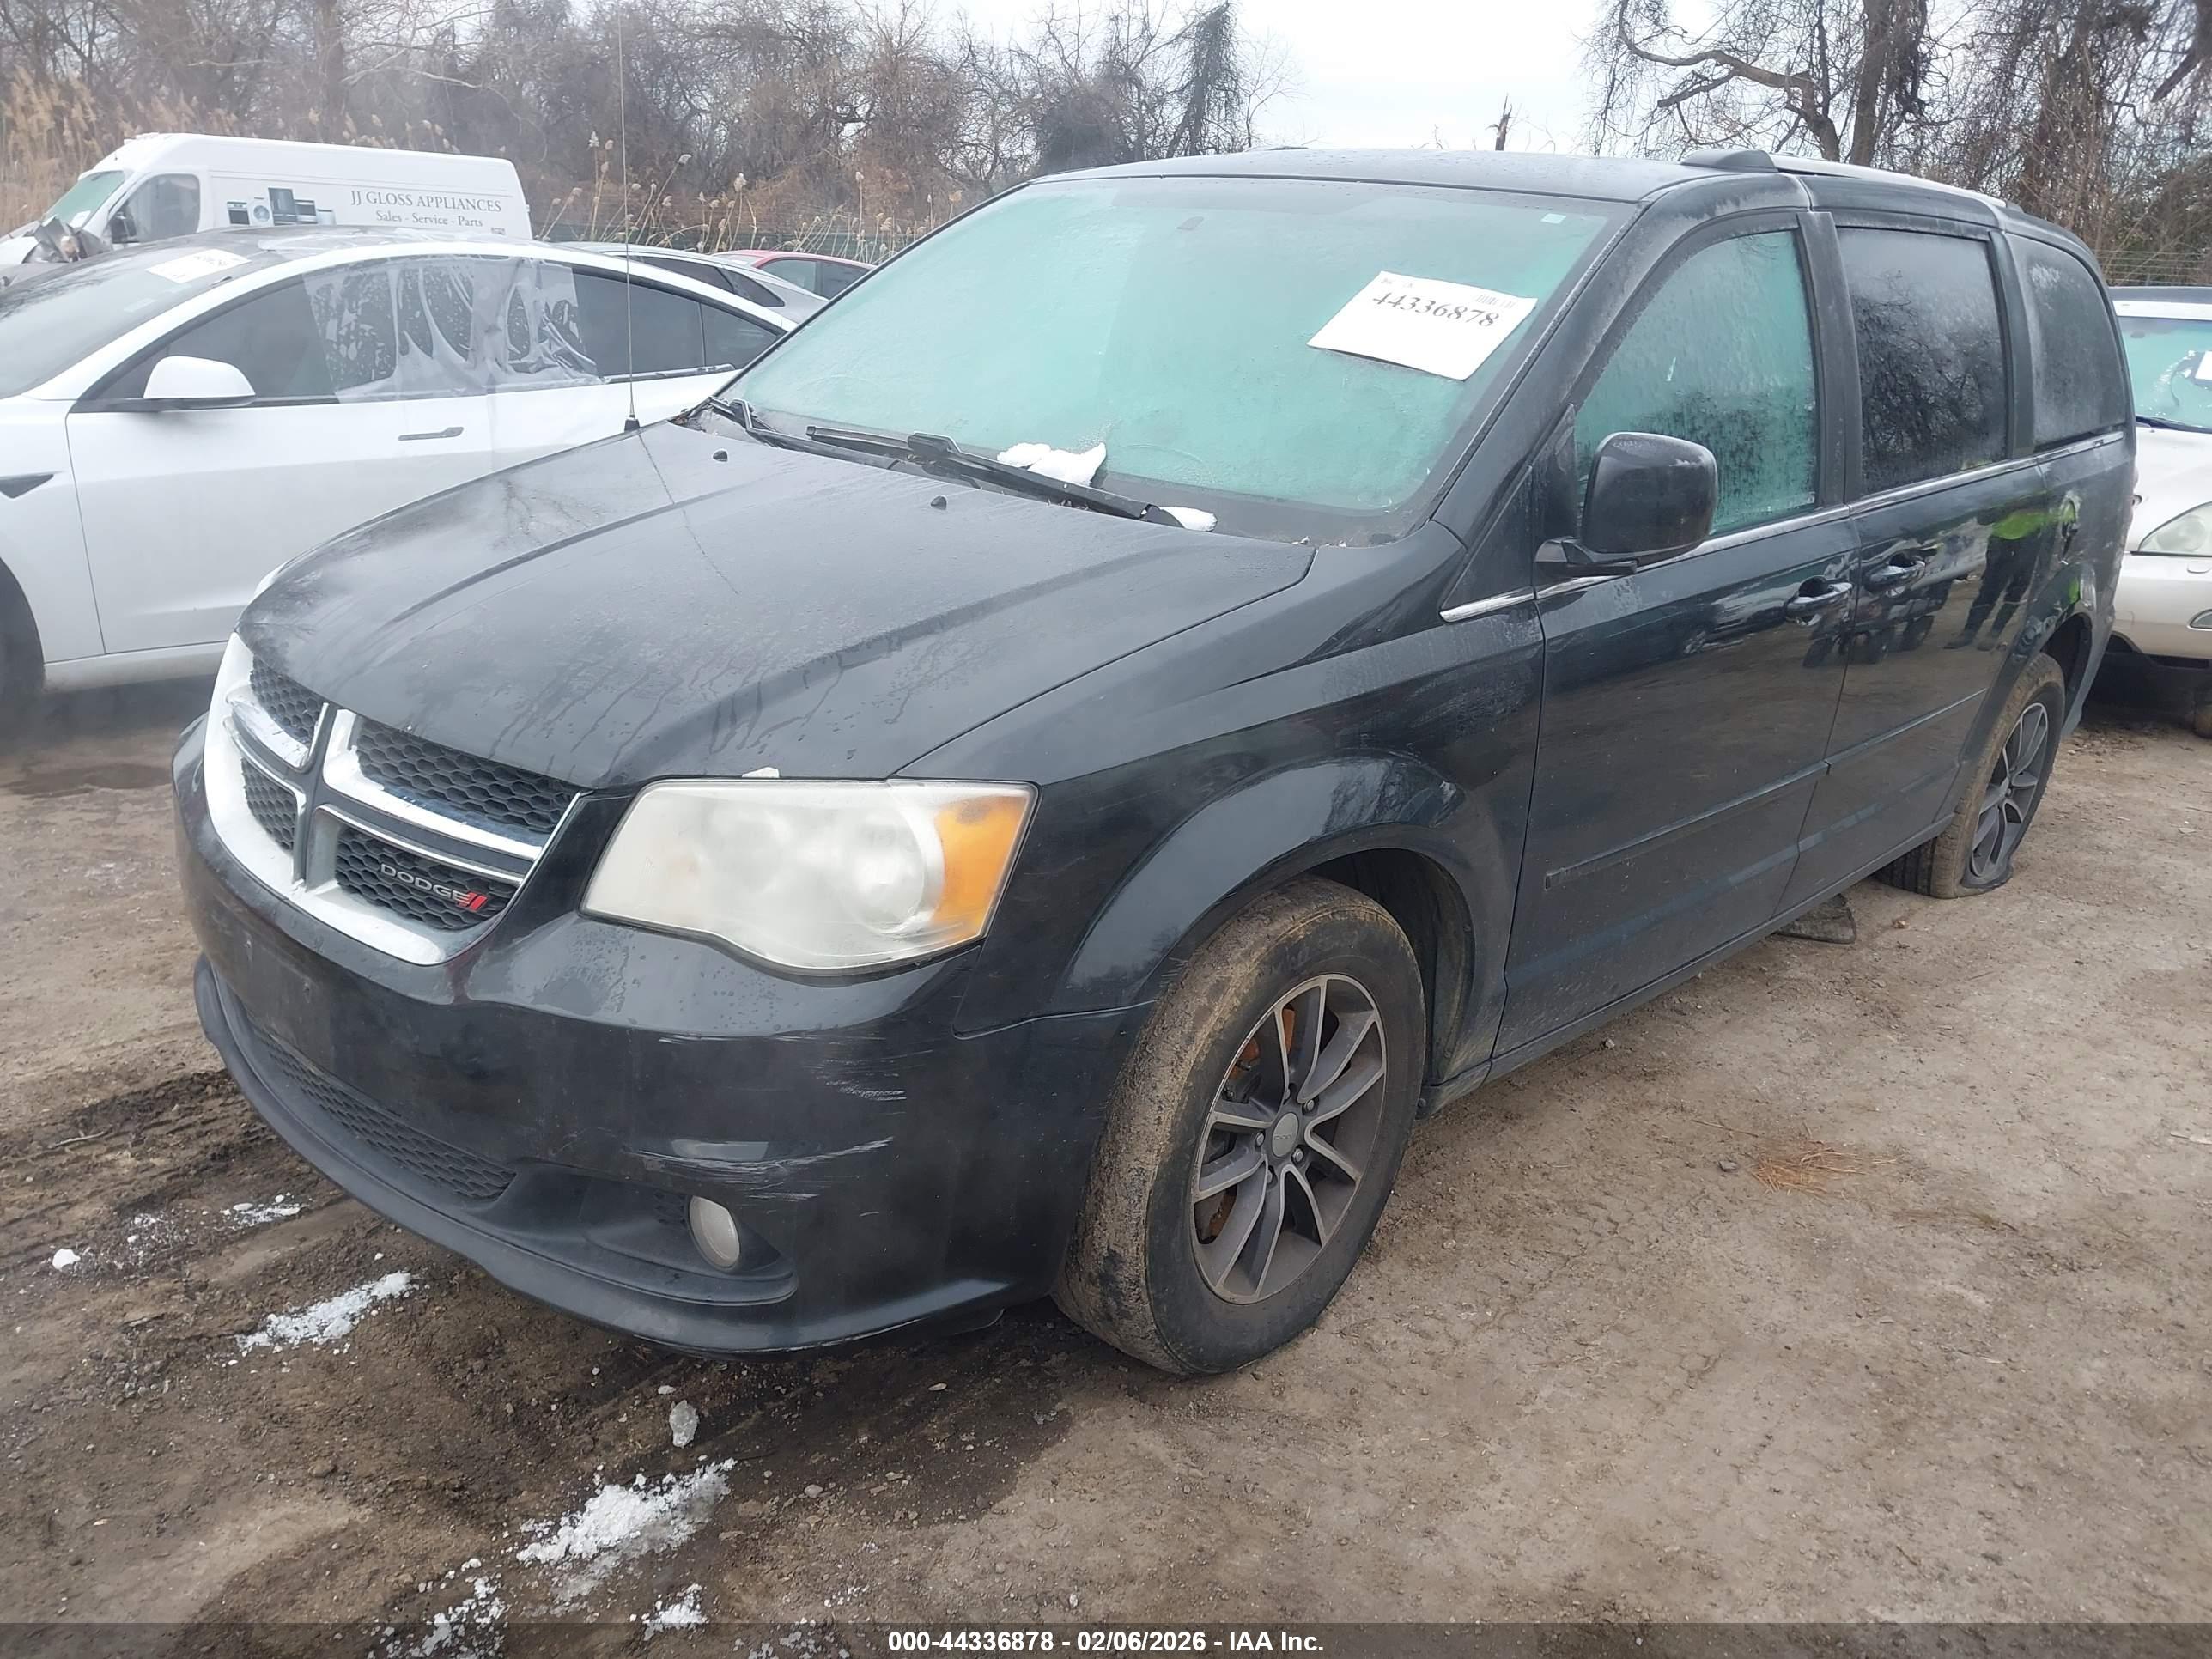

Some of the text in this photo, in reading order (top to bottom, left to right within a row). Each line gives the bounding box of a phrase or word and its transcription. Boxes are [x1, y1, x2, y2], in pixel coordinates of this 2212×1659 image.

[350, 191, 502, 212] JJ GLOSS APPLIANCES
[376, 210, 402, 222] Sales
[412, 212, 448, 225] Service
[458, 215, 483, 227] Parts
[1373, 292, 1499, 327] 44336878
[380, 863, 471, 906] DODGE
